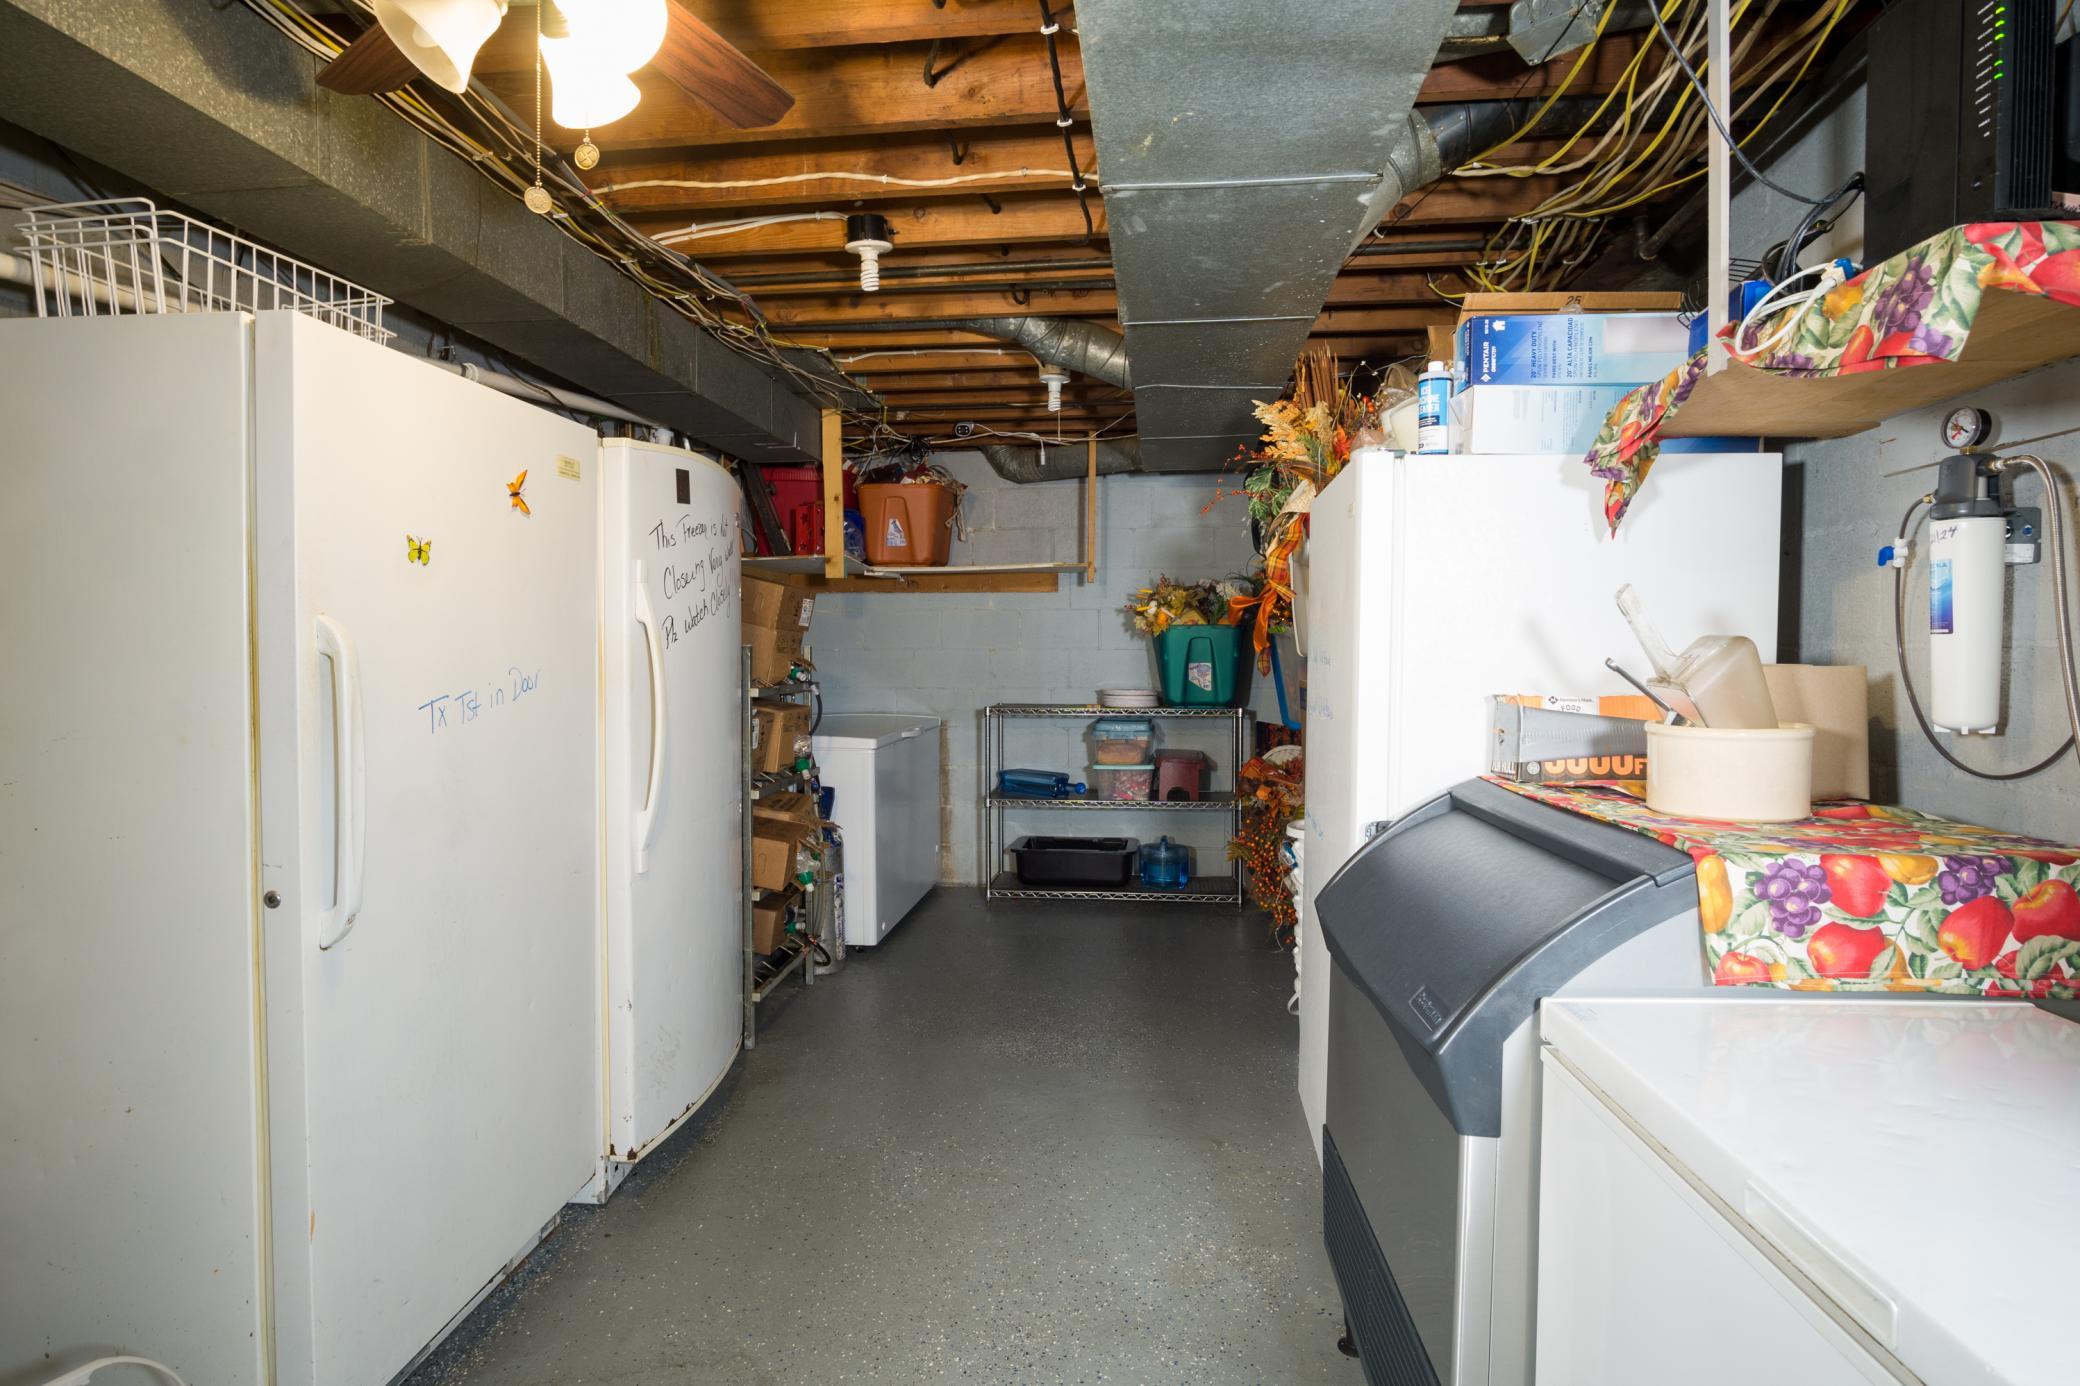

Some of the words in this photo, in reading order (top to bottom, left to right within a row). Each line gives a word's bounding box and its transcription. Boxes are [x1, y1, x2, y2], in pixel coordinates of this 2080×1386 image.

[1565, 295, 1582, 306] 25
[1482, 341, 1490, 373] PENTAIR
[649, 519, 677, 551] This
[711, 518, 718, 537] is
[417, 694, 450, 735] Tx
[488, 681, 505, 709] in
[508, 665, 542, 702] Door
